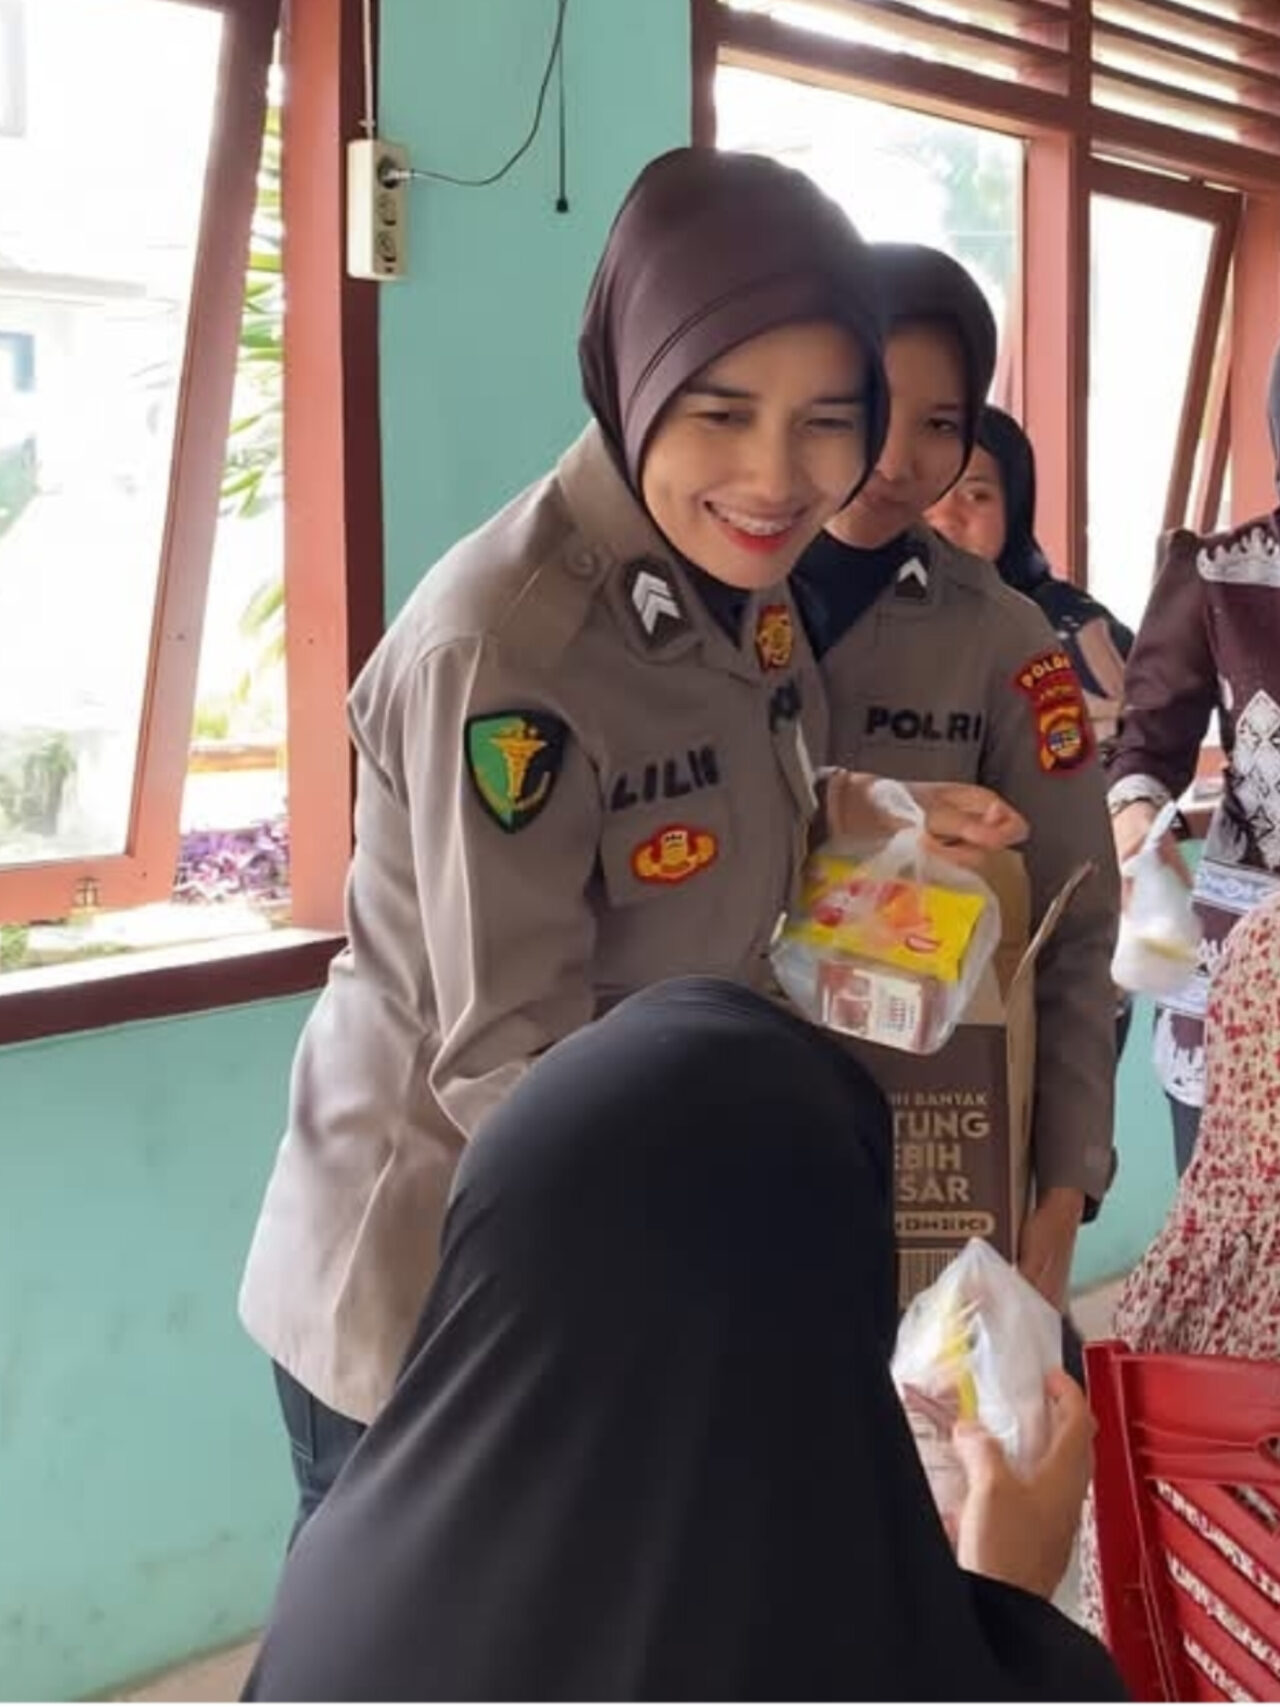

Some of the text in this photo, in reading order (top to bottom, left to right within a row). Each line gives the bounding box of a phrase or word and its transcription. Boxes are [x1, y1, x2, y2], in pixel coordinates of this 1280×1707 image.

[866, 706, 983, 741] POLRI
[914, 1092, 988, 1106] BANYAK
[894, 1142, 962, 1171] BIH
